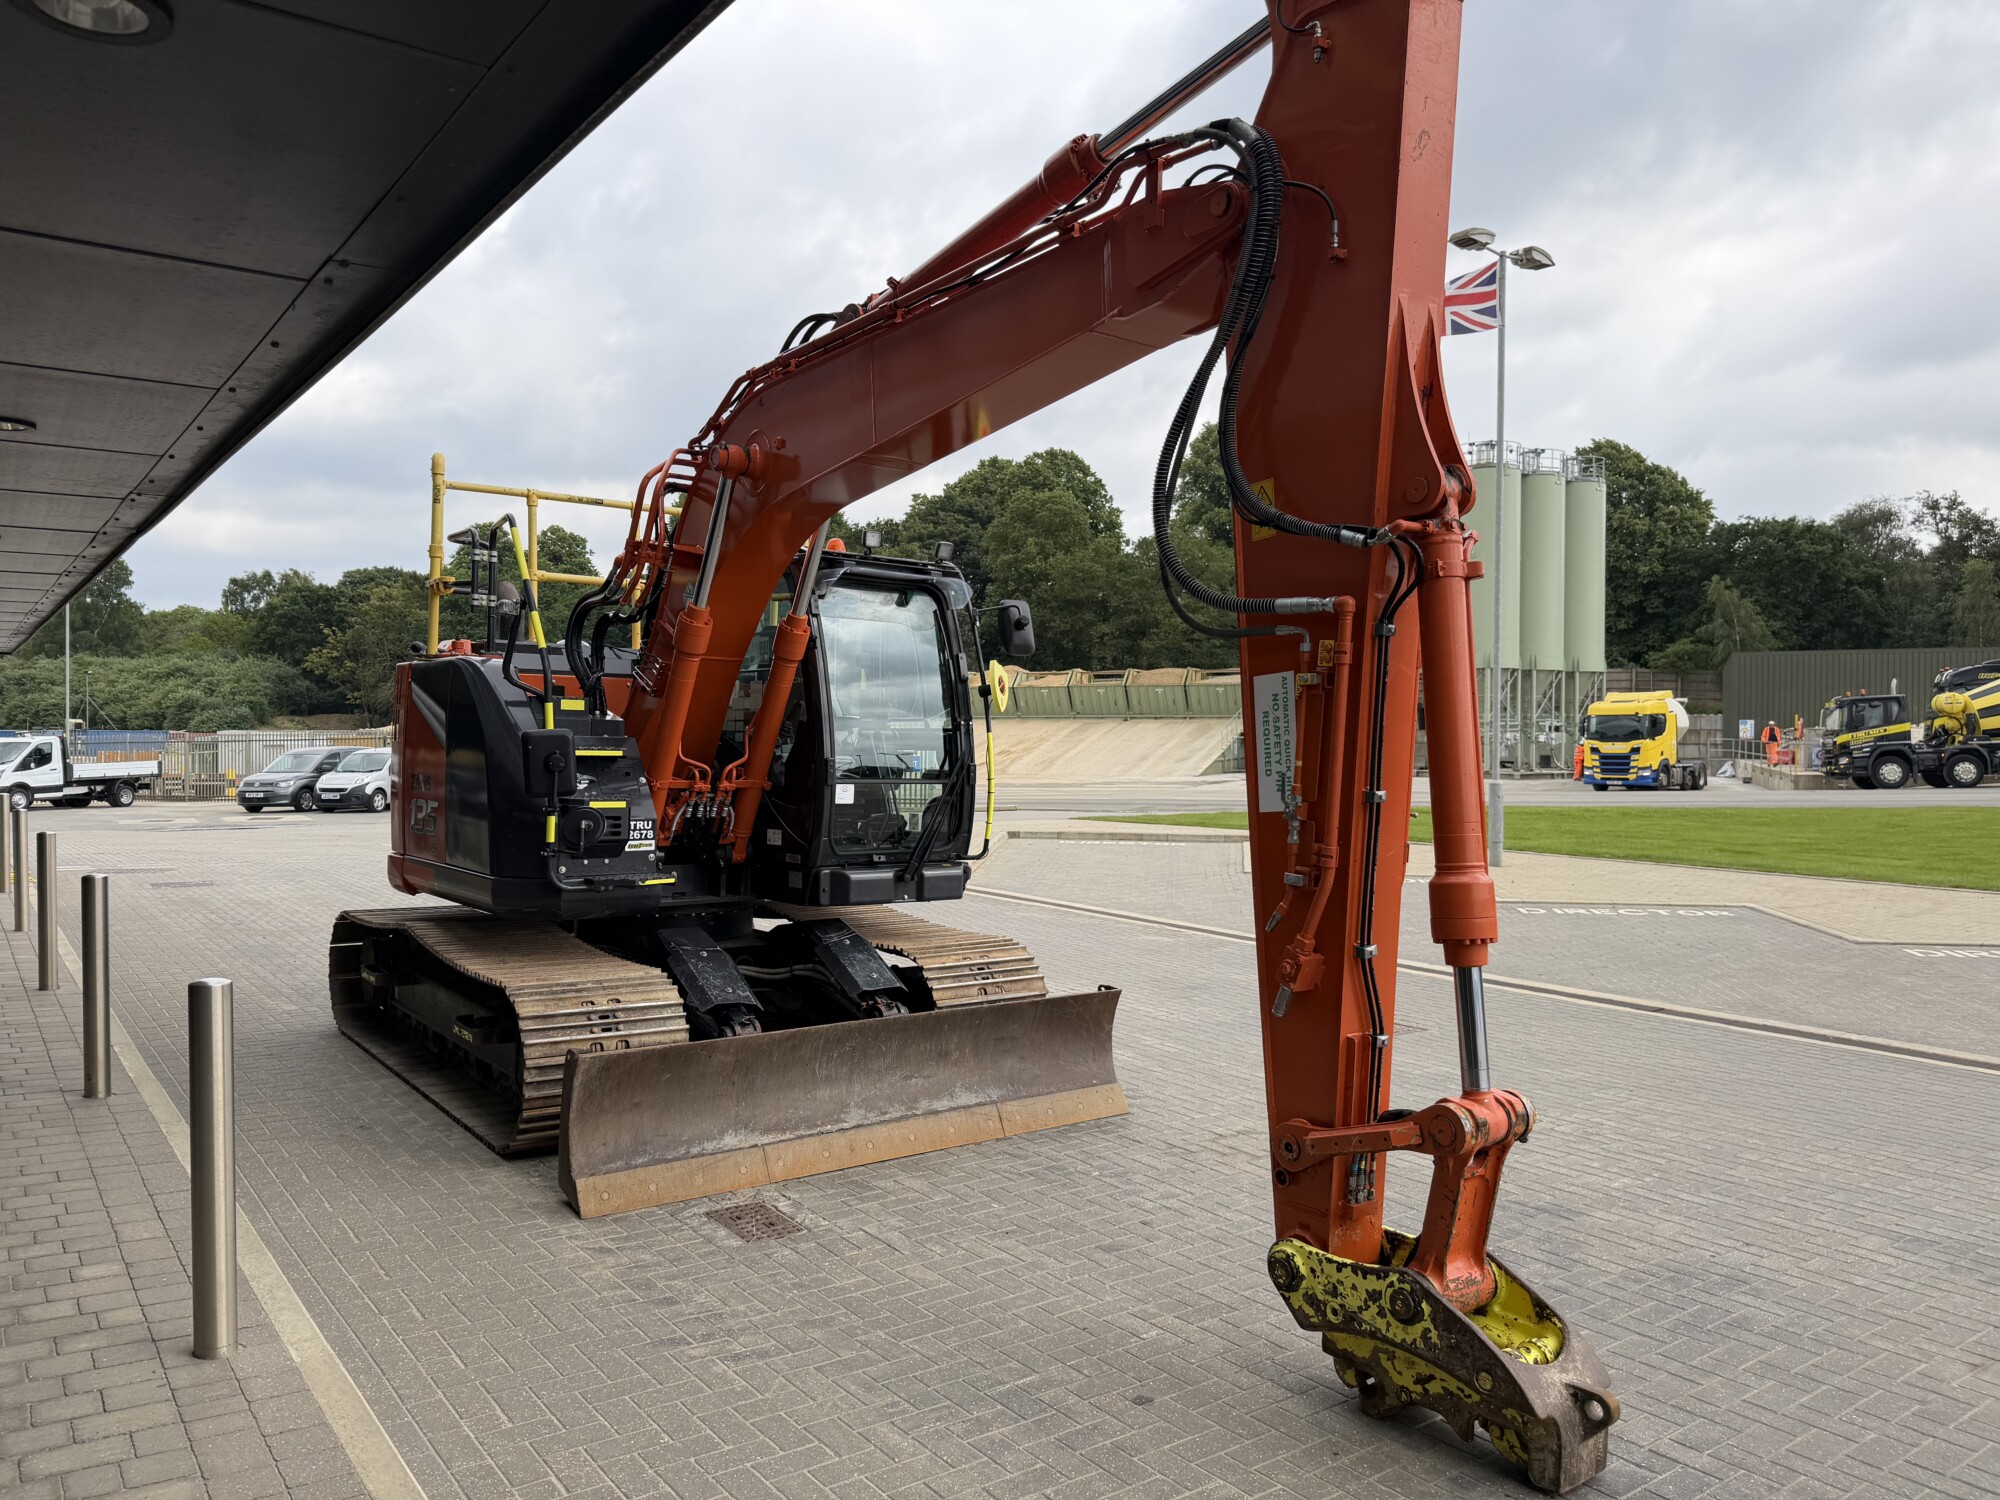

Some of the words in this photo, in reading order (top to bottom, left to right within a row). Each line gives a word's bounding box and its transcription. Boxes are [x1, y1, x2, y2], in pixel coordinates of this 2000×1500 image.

[1271, 692, 1280, 712] NO
[1281, 675, 1290, 736] AUTOMATIC
[1262, 710, 1273, 777] REQUIRED
[1273, 716, 1283, 766] SAFETY
[1284, 737, 1292, 773] QUICK
[1275, 770, 1283, 793] PIN
[409, 798, 439, 836] 135
[629, 820, 653, 830] TRU
[629, 830, 654, 839] 2678
[1515, 906, 1736, 917] DIRECTOR
